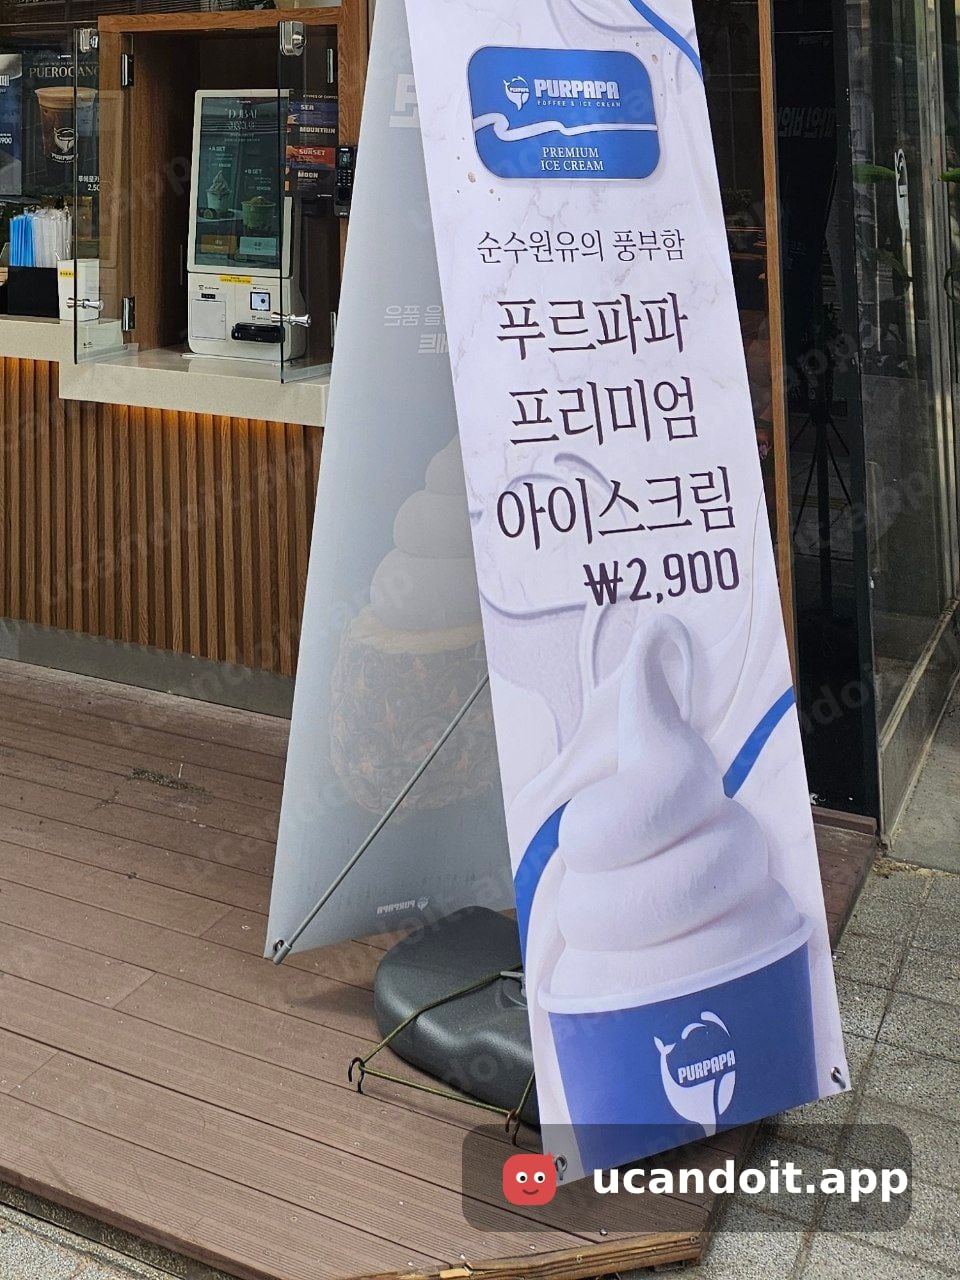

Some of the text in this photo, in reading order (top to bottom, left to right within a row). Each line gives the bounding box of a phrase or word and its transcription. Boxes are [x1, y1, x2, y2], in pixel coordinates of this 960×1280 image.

[534, 78, 620, 99] PURPAPA
[299, 126, 336, 134] MOUNTAIN
[540, 160, 604, 171] ICE CREAM
[542, 147, 599, 158] PREMIUM
[297, 171, 319, 179] MOON
[476, 228, 685, 265] 순수원유의 풍부함
[496, 292, 689, 361] 푸르파파
[508, 376, 699, 446] 프리미엄
[496, 466, 736, 551] 아이스크림
[582, 547, 741, 607] ₩2,900
[677, 1049, 736, 1083] PURPAPA
